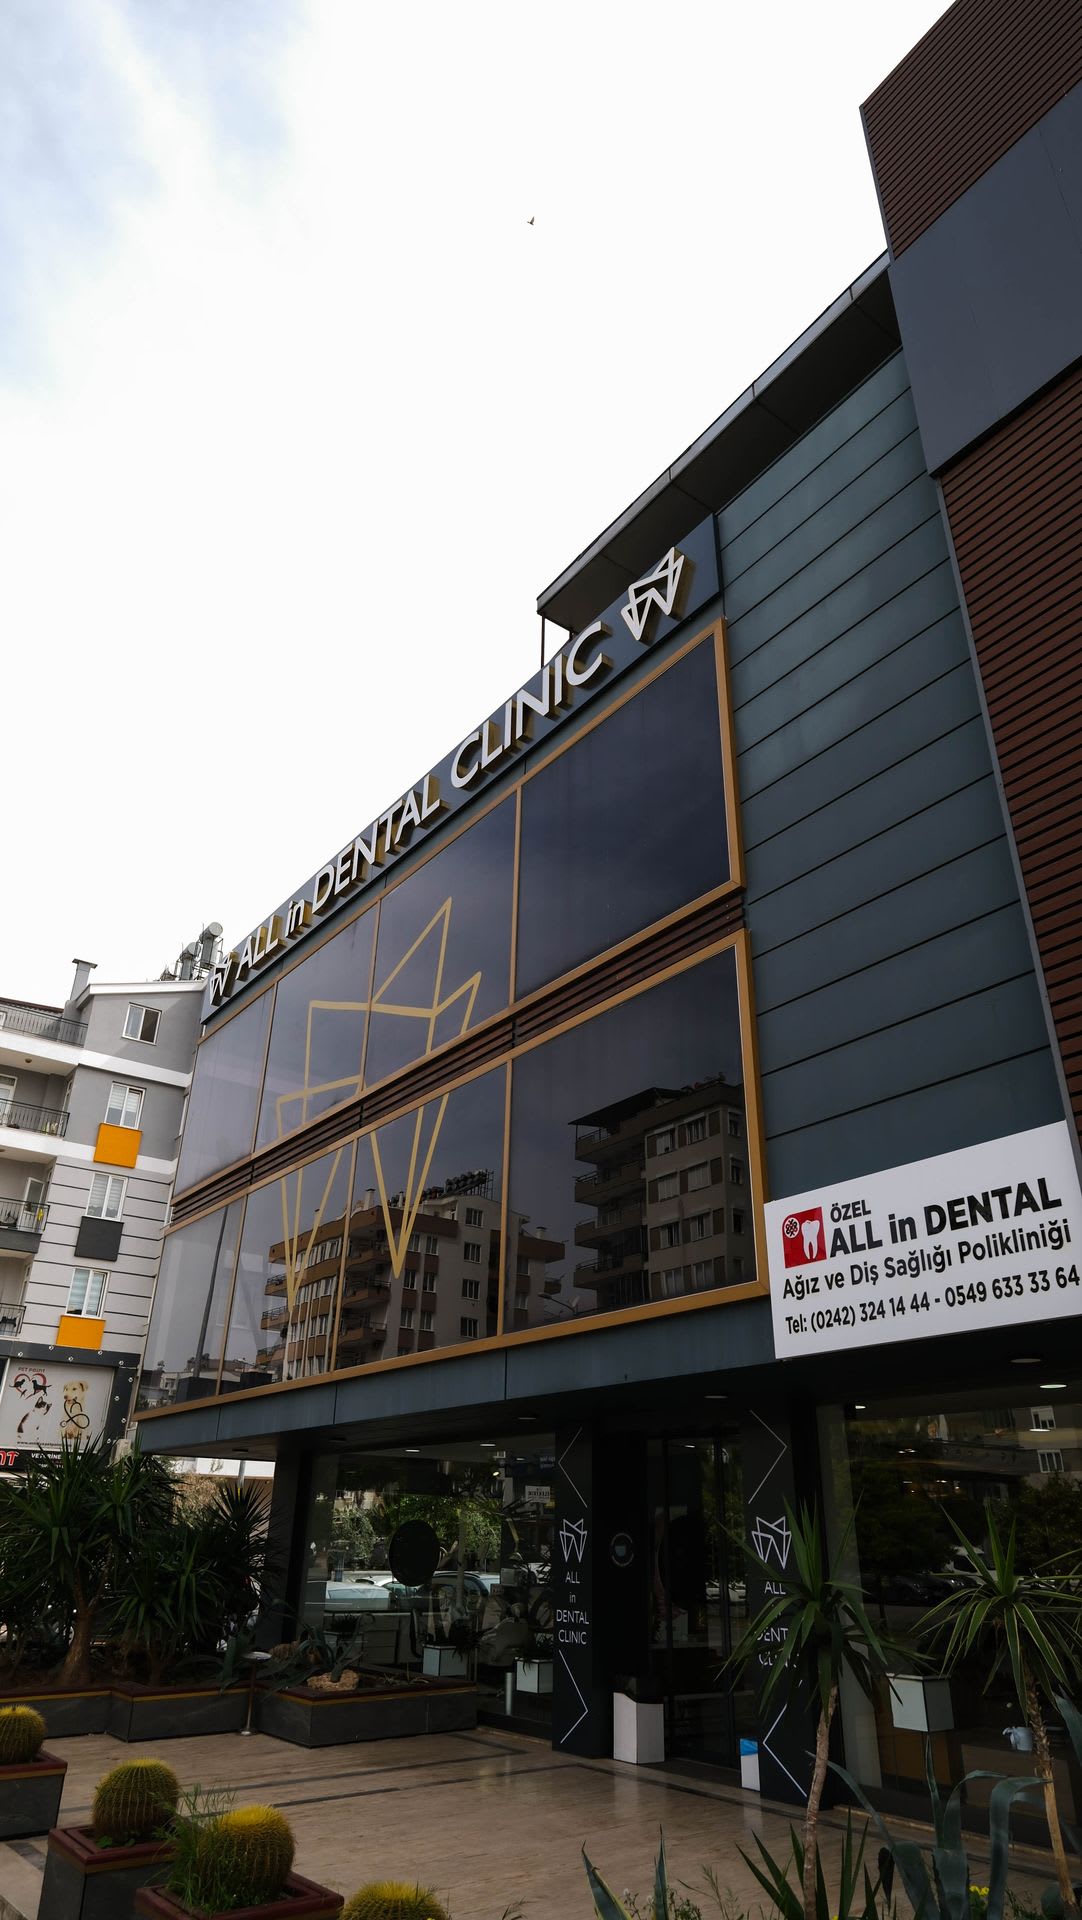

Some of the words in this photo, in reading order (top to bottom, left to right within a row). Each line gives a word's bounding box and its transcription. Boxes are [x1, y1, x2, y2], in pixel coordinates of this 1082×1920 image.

[236, 915, 280, 979] ALL
[285, 899, 307, 939] in
[312, 773, 442, 915] DENTAL
[451, 621, 606, 789] CLINIC
[829, 1199, 871, 1223] ÖZEL
[829, 1220, 883, 1258] ALL
[888, 1213, 917, 1244] in
[923, 1177, 1063, 1237] DENTAL
[783, 1275, 820, 1301] Ağız
[824, 1271, 845, 1290] ve
[850, 1262, 879, 1285] Diş
[884, 1245, 952, 1279] Sağlığı
[957, 1218, 1072, 1264] Polikliniği
[785, 1314, 808, 1335] Tel:
[811, 1305, 856, 1334] (0242)
[860, 1299, 886, 1322] 324
[889, 1296, 906, 1316] 14
[910, 1291, 930, 1312] 44
[945, 1281, 988, 1308] 0549
[992, 1274, 1025, 1300] 633
[1028, 1269, 1051, 1293] 33
[1055, 1264, 1081, 1288] 64
[565, 1571, 580, 1584] ALL
[764, 1581, 786, 1595] ALL
[569, 1594, 576, 1604] in
[556, 1609, 590, 1625] DENTAL
[558, 1630, 587, 1645] CLINIC
